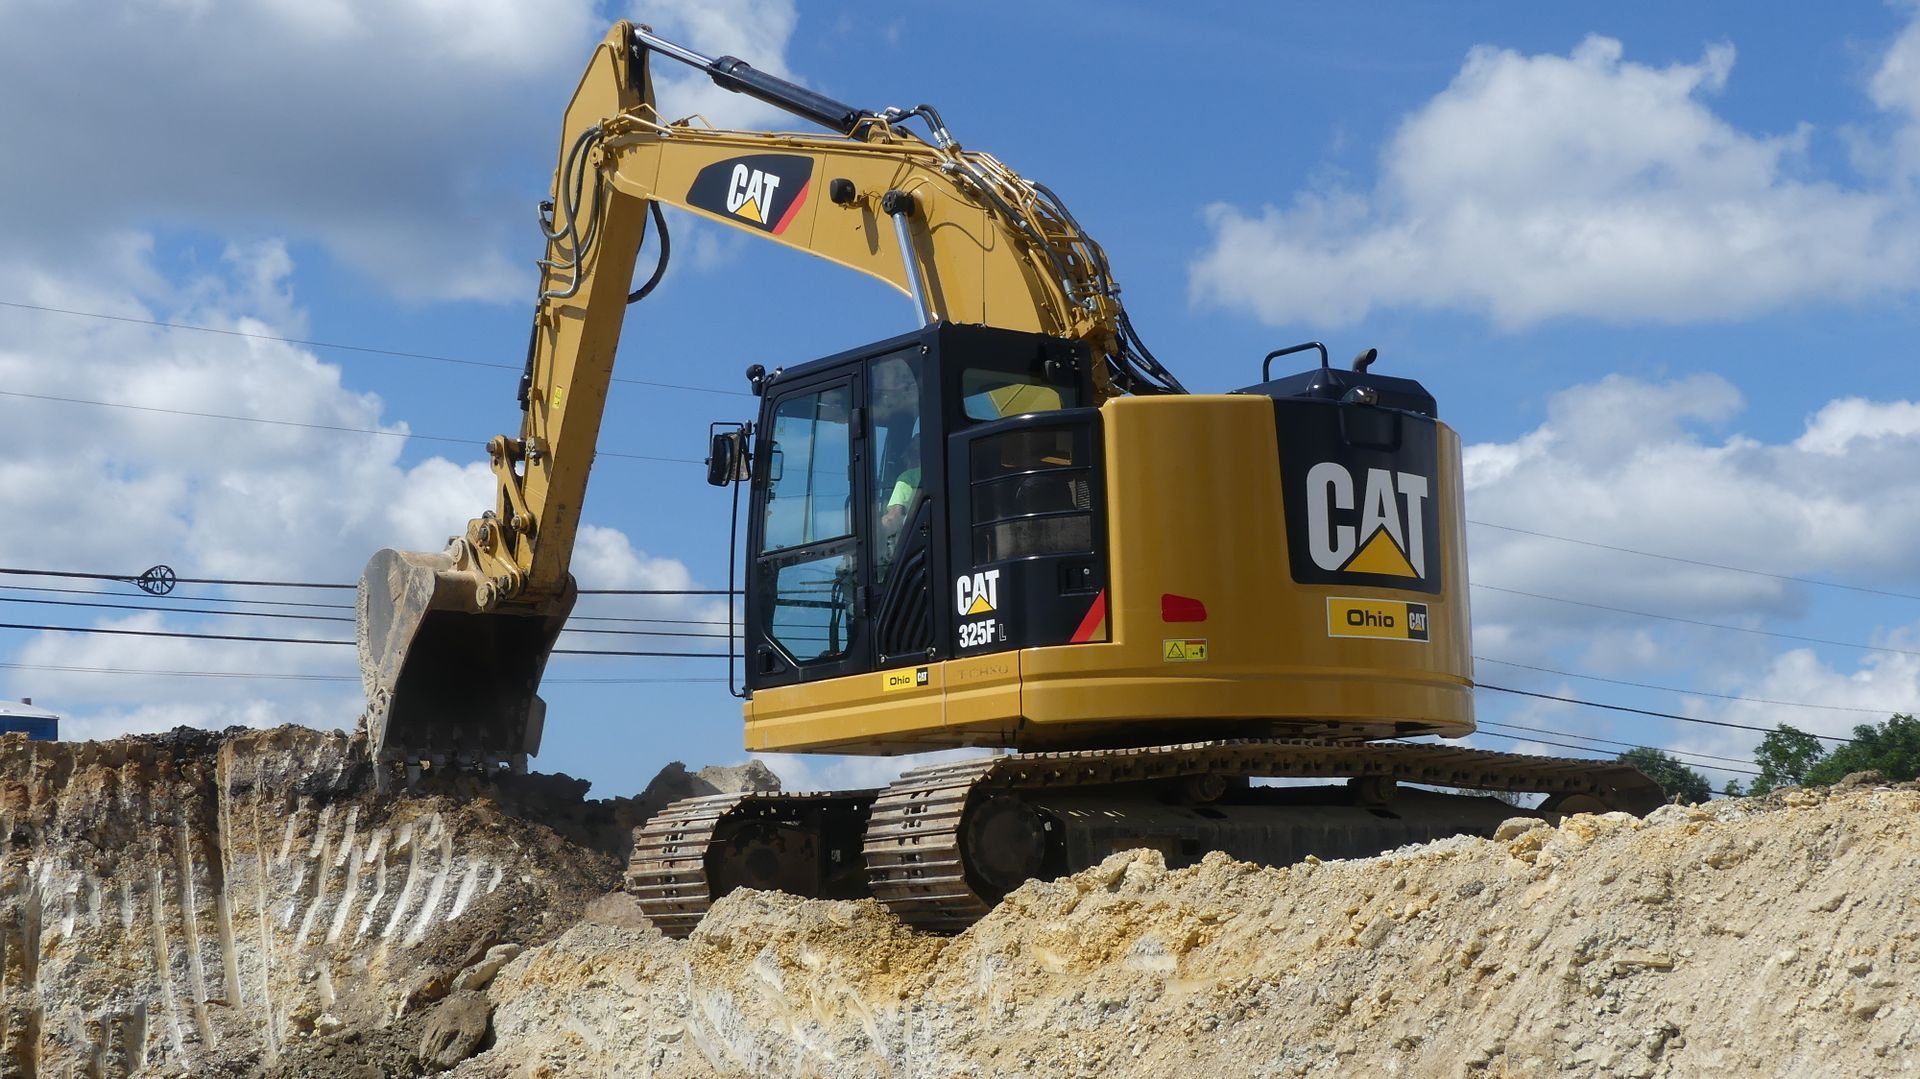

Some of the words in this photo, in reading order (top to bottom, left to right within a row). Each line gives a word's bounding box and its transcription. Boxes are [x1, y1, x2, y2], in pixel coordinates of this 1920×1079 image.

[727, 163, 780, 224] CAT
[1306, 462, 1428, 580] CAT
[957, 569, 999, 616] CAT
[959, 619, 996, 648] 325F
[999, 623, 1007, 641] L
[1347, 609, 1395, 627] Ohio
[1408, 612, 1426, 631] CAT
[890, 675, 911, 686] Ohio
[917, 671, 928, 683] CAT
